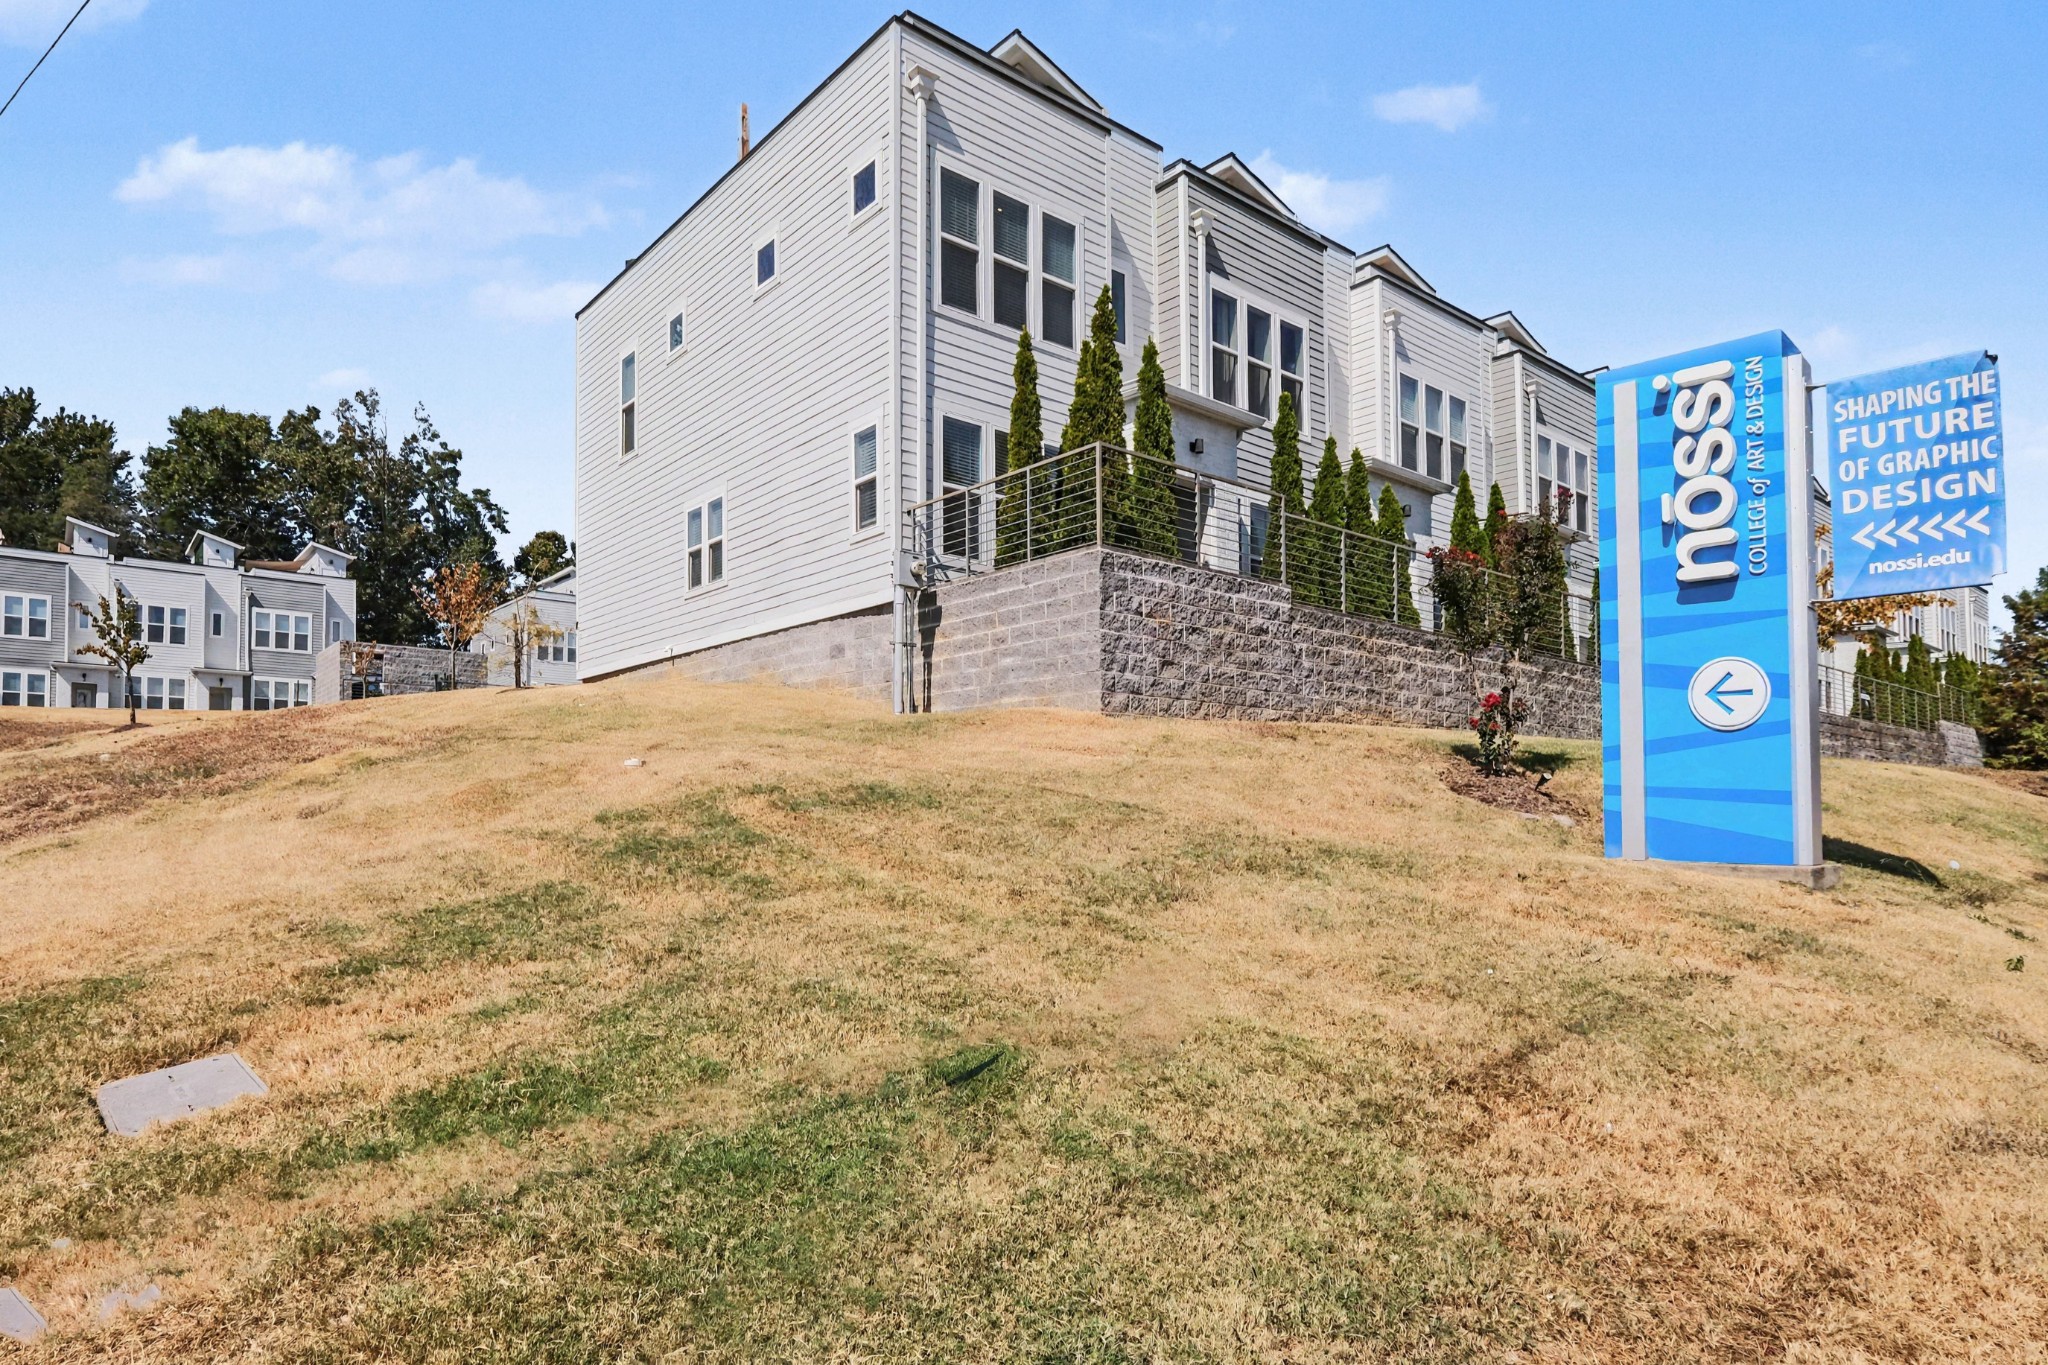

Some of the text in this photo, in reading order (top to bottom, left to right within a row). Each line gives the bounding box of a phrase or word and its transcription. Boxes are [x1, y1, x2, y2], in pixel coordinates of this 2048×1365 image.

[1834, 370, 1996, 422] SHAPING THE
[1839, 402, 1995, 453] FUTURE
[1745, 356, 1770, 575] COLLEGE of ART & DESIGN
[1839, 436, 1997, 481] OF GRAPHIC
[1842, 468, 1996, 514] DESIGN
[1869, 549, 1971, 574] nossi.edu
